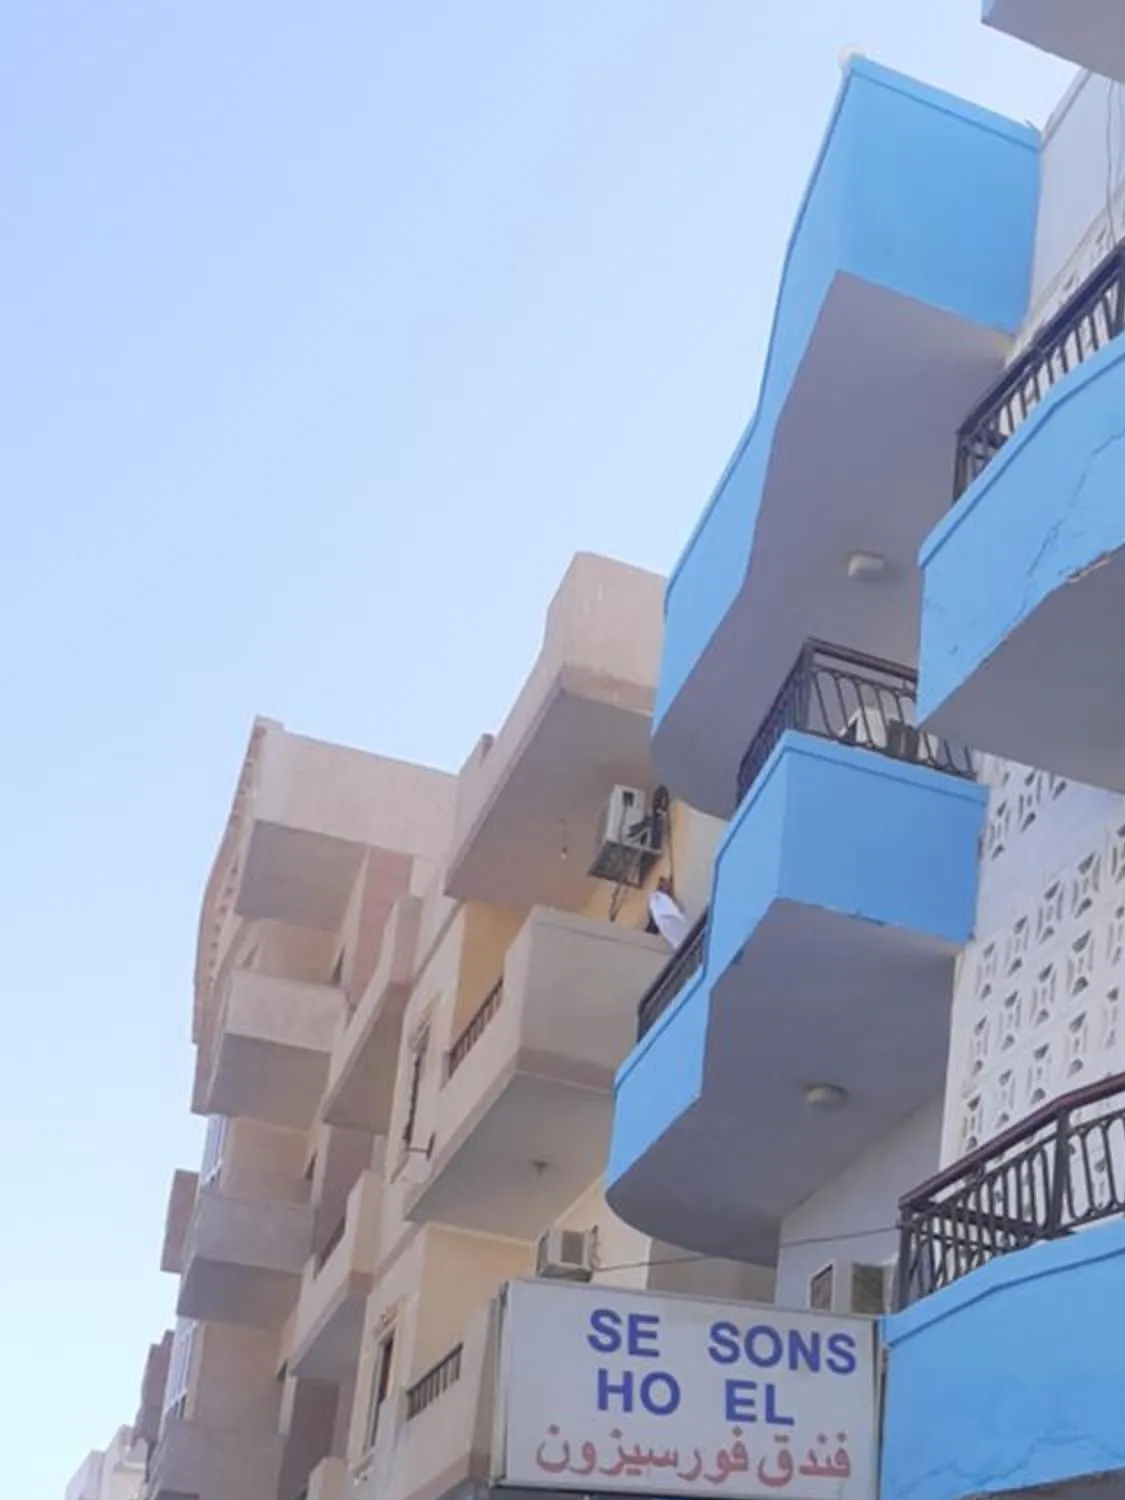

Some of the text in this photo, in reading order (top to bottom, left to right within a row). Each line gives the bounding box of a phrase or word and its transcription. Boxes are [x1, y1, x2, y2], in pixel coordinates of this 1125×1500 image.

[586, 1308, 857, 1376] SE SONS
[597, 1367, 796, 1427] HO EL
[535, 1423, 852, 1487] فندق فورسيزون
